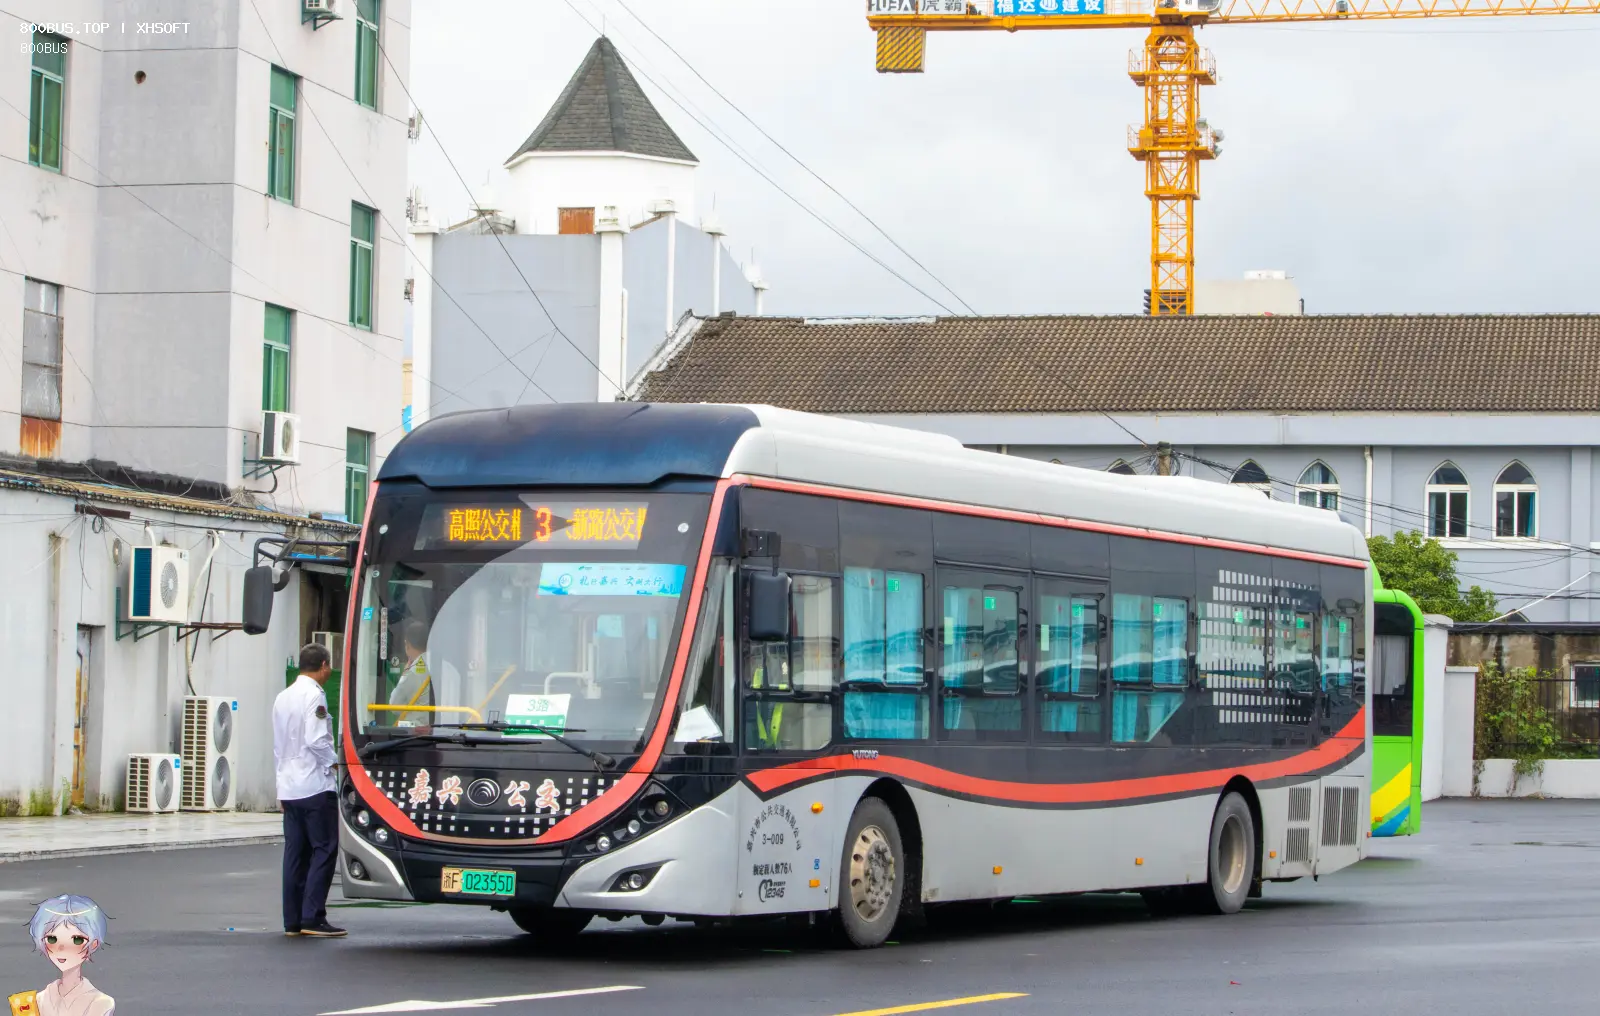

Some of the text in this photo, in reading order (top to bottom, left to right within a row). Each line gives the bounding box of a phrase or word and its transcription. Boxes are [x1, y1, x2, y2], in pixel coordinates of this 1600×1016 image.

[535, 507, 551, 542] 3
[852, 749, 879, 760] YUTONG
[408, 769, 561, 811] 嘉兴 公交
[762, 833, 784, 845] 3-009
[765, 887, 785, 899] 12345
